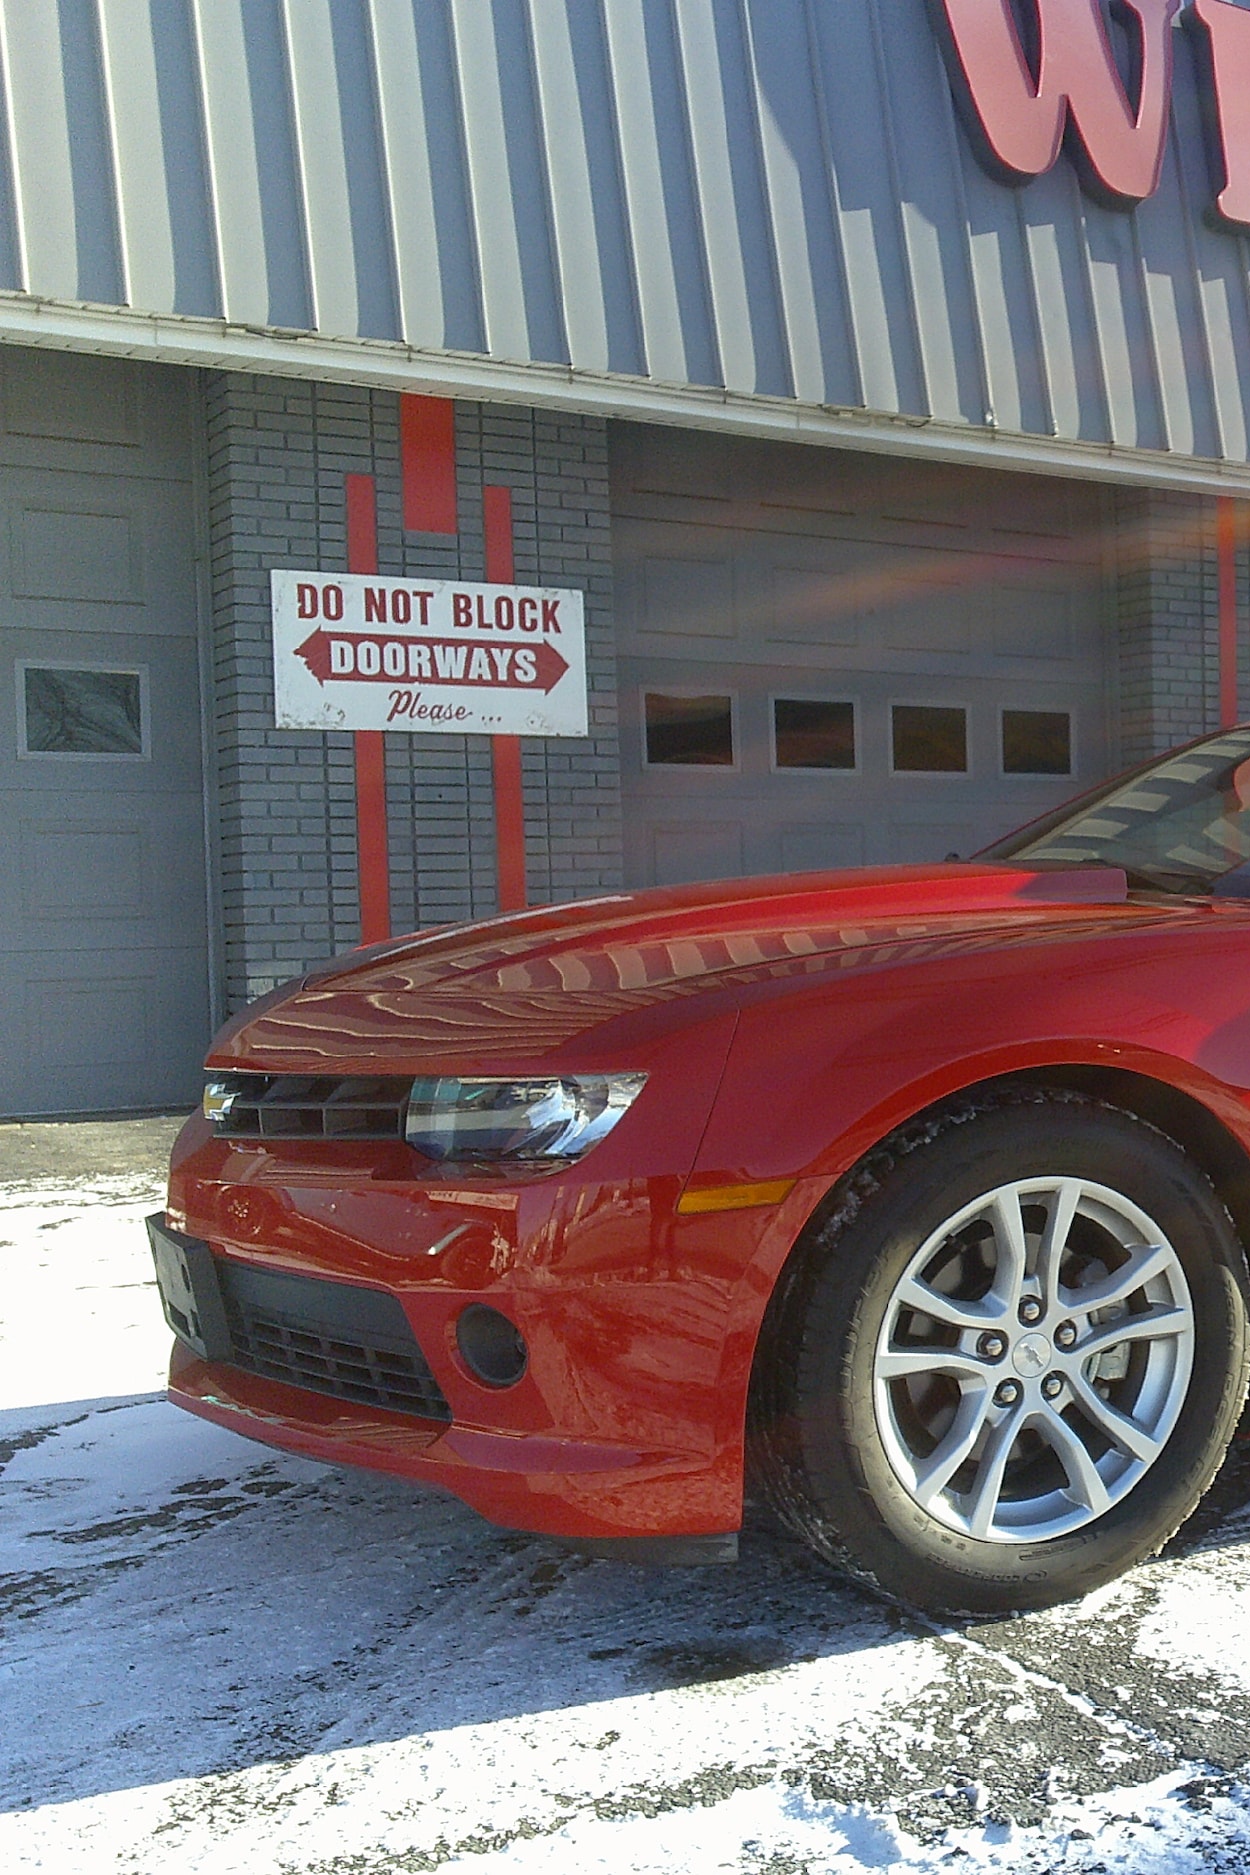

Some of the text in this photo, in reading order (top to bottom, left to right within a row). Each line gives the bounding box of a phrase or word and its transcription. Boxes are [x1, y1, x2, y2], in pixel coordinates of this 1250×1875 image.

[296, 583, 562, 634] DO NOT BLOCK
[330, 640, 537, 683] DOORWAYS
